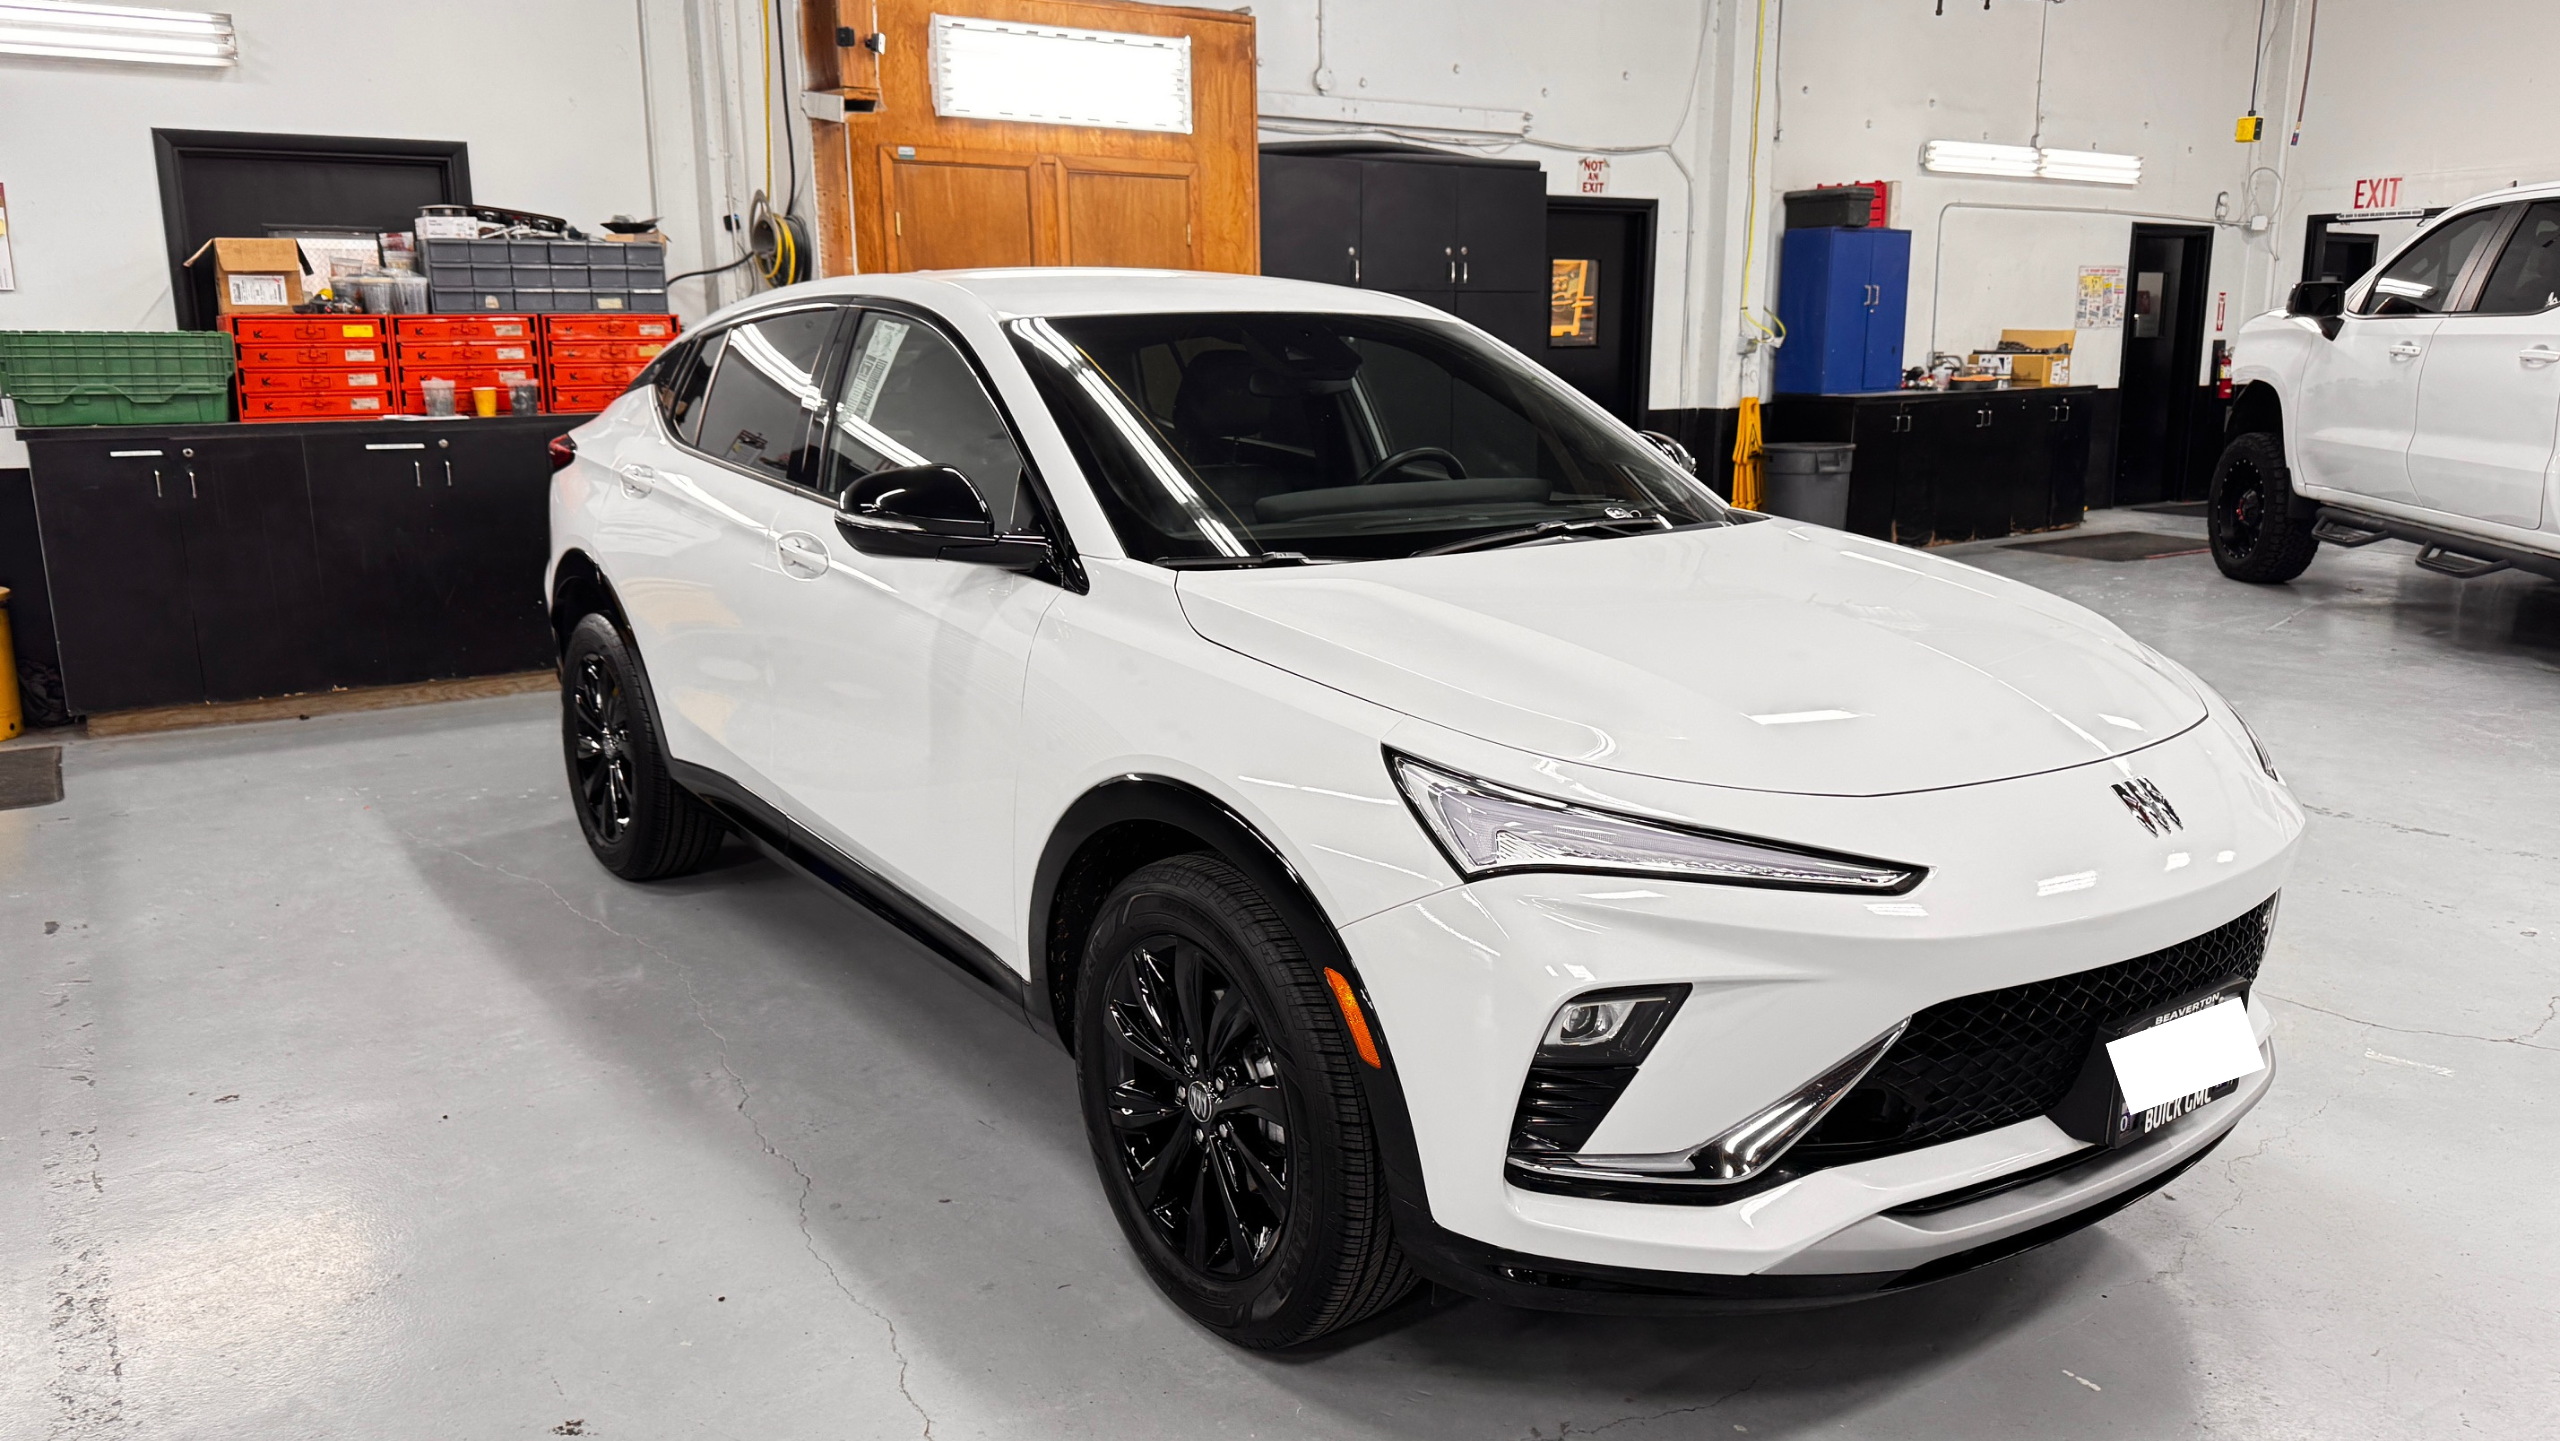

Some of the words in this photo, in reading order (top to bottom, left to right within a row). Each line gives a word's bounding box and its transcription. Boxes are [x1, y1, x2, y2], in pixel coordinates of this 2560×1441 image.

[1583, 160, 1604, 171] NOT
[1588, 172, 1599, 180] AN
[1582, 182, 1605, 193] EXIT
[2353, 177, 2403, 209] EXIT
[2155, 992, 2220, 1026] BEAVERTON
[2144, 1098, 2182, 1134] BUICK
[2184, 1088, 2212, 1113] GMC
